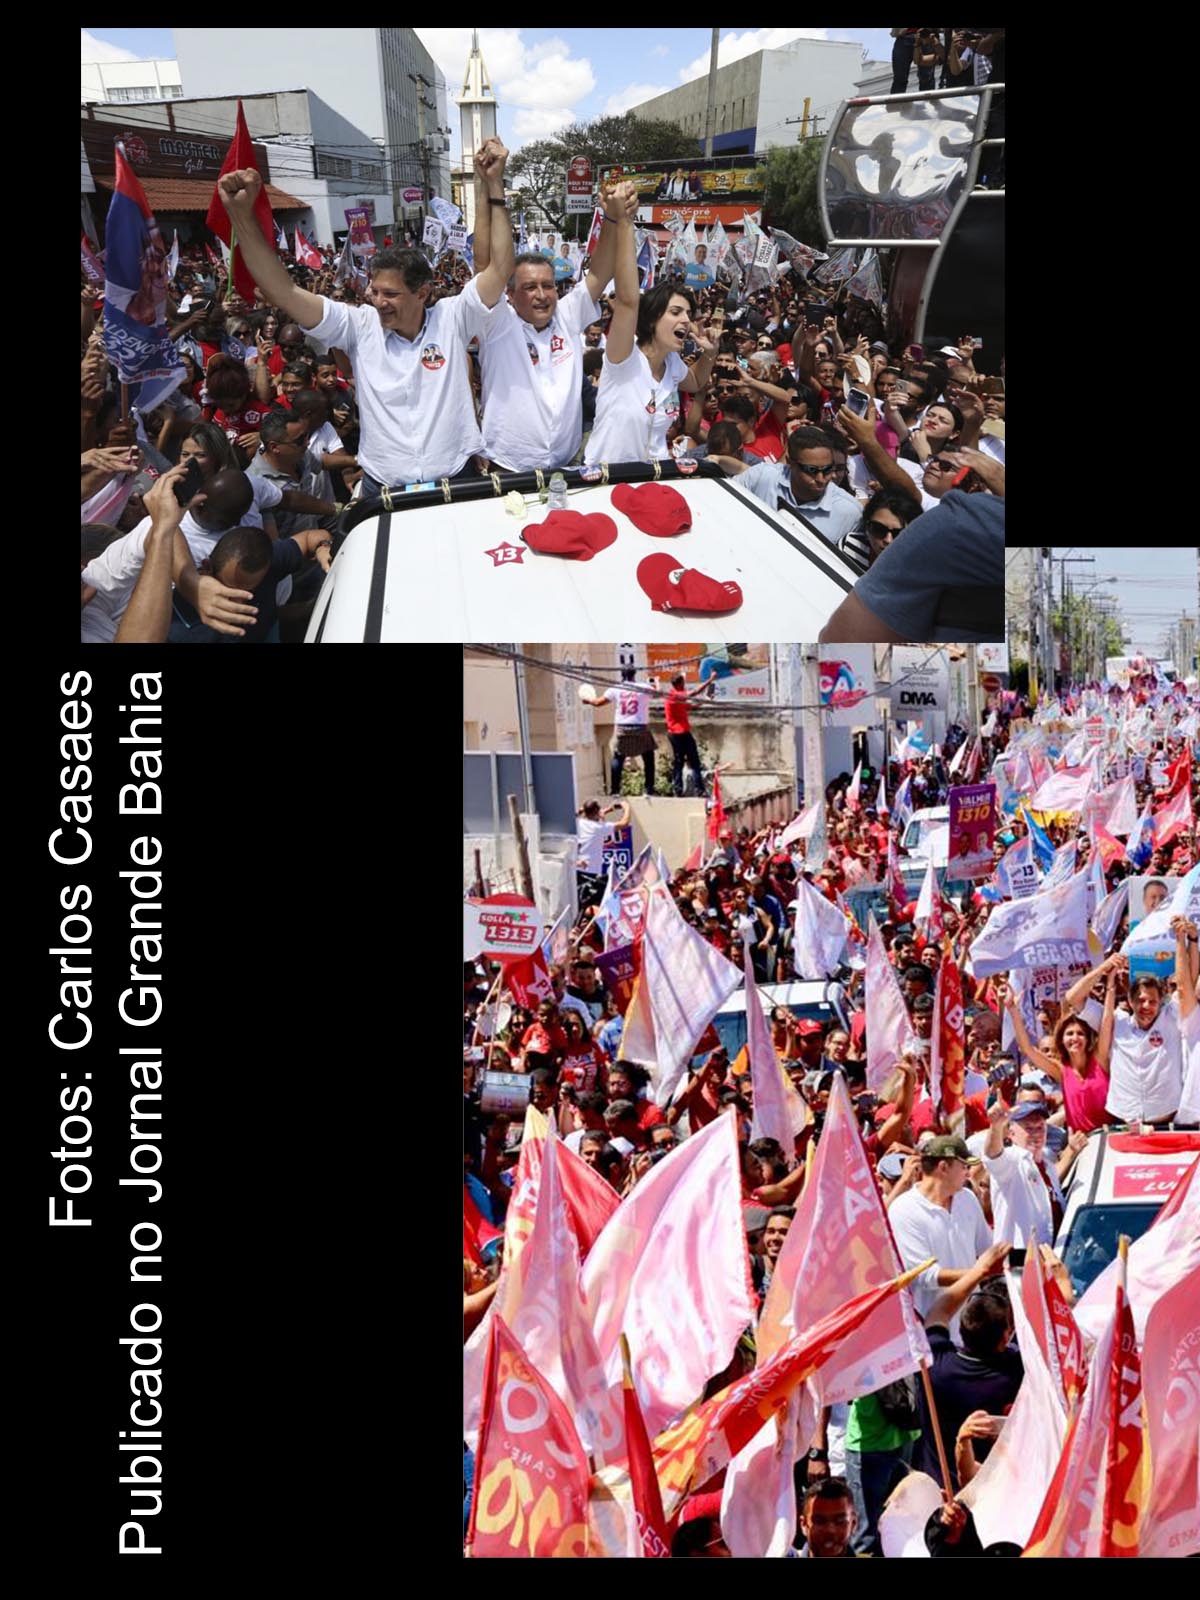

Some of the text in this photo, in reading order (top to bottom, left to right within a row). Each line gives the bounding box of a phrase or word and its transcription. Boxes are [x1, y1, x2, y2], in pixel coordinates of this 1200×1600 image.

[160, 138, 220, 160] MASTER
[494, 547, 519, 563] 13
[900, 691, 937, 706] DMA
[619, 699, 640, 715] 13
[957, 804, 991, 823] 1310
[1022, 865, 1035, 877] 13
[480, 914, 511, 924] SOLLA
[487, 927, 534, 941] 1313
